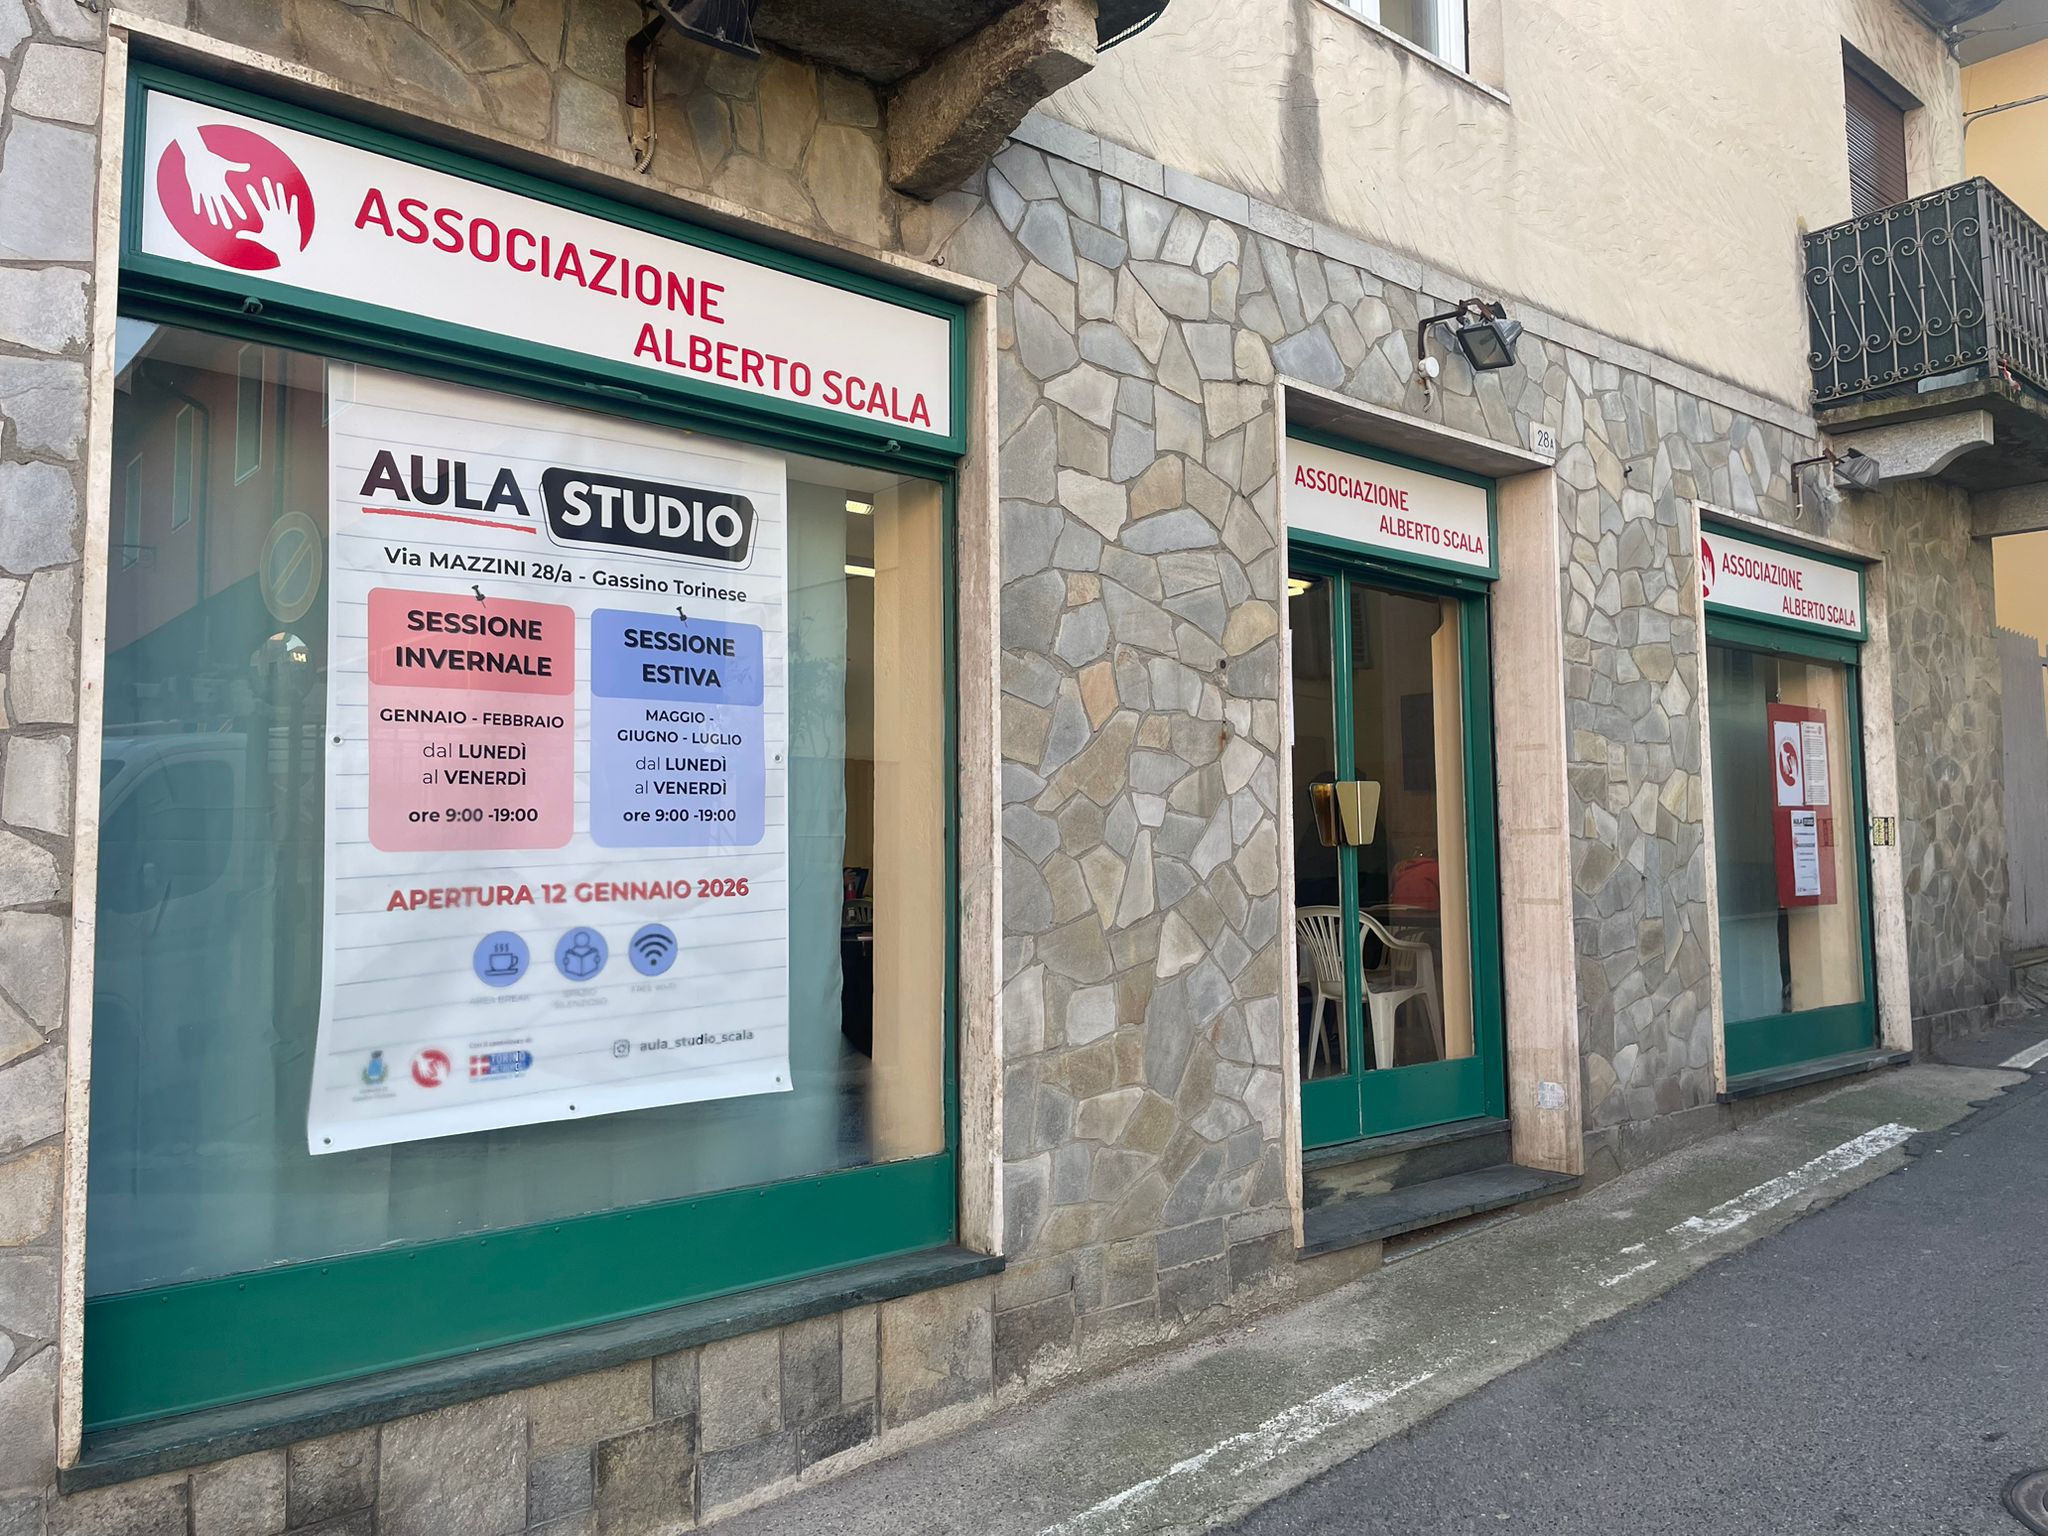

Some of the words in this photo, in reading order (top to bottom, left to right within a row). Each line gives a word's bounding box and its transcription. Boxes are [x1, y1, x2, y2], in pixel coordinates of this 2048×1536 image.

[354, 187, 725, 324] ASSOCIAZIONE
[633, 323, 812, 398] ALBERTO
[823, 369, 932, 428] SCALA
[359, 449, 531, 517] AULA
[561, 480, 744, 548] STUDIO
[1294, 464, 1409, 512] ASSOCIAZIONE
[1379, 514, 1440, 544] ALBERTO
[1443, 529, 1484, 555] SCALA
[384, 546, 421, 567] Via
[429, 551, 526, 577] MAZZINI
[532, 562, 573, 584] 28/a
[592, 570, 668, 594] Gassino
[673, 579, 747, 603] Torinese
[1722, 552, 1803, 591] ASSOCIAZIONE
[407, 609, 543, 641] SESSIONE
[1782, 595, 1826, 621] ALBERTO
[1827, 605, 1856, 627] SCALA
[623, 628, 735, 658] SESSIONE
[395, 646, 552, 677] INVERNALE
[642, 663, 722, 689] ESTIVA
[380, 708, 467, 724] GENNAIO
[483, 712, 564, 728] FEBBRAIO
[646, 709, 705, 723] MAGGIO
[423, 742, 452, 758] dal
[458, 743, 526, 760] LUNEDÌ
[617, 729, 679, 743] GIUGNO
[692, 732, 742, 746] LUGLIO
[422, 769, 438, 784] al
[444, 768, 526, 785] VENERDÌ
[635, 756, 660, 770] dal
[665, 756, 727, 772] LUNEDÌ
[635, 780, 648, 794] al
[653, 779, 727, 795] VENERDÌ
[408, 810, 440, 822] ore
[445, 808, 483, 822] 9:00
[623, 811, 651, 822] ore
[655, 809, 689, 822] 9:00
[386, 884, 534, 912] APERTURA
[542, 883, 567, 905] 12
[574, 879, 692, 903] GENNAIO
[697, 877, 750, 898] 2026
[640, 1029, 754, 1052] aula_studio_scala
